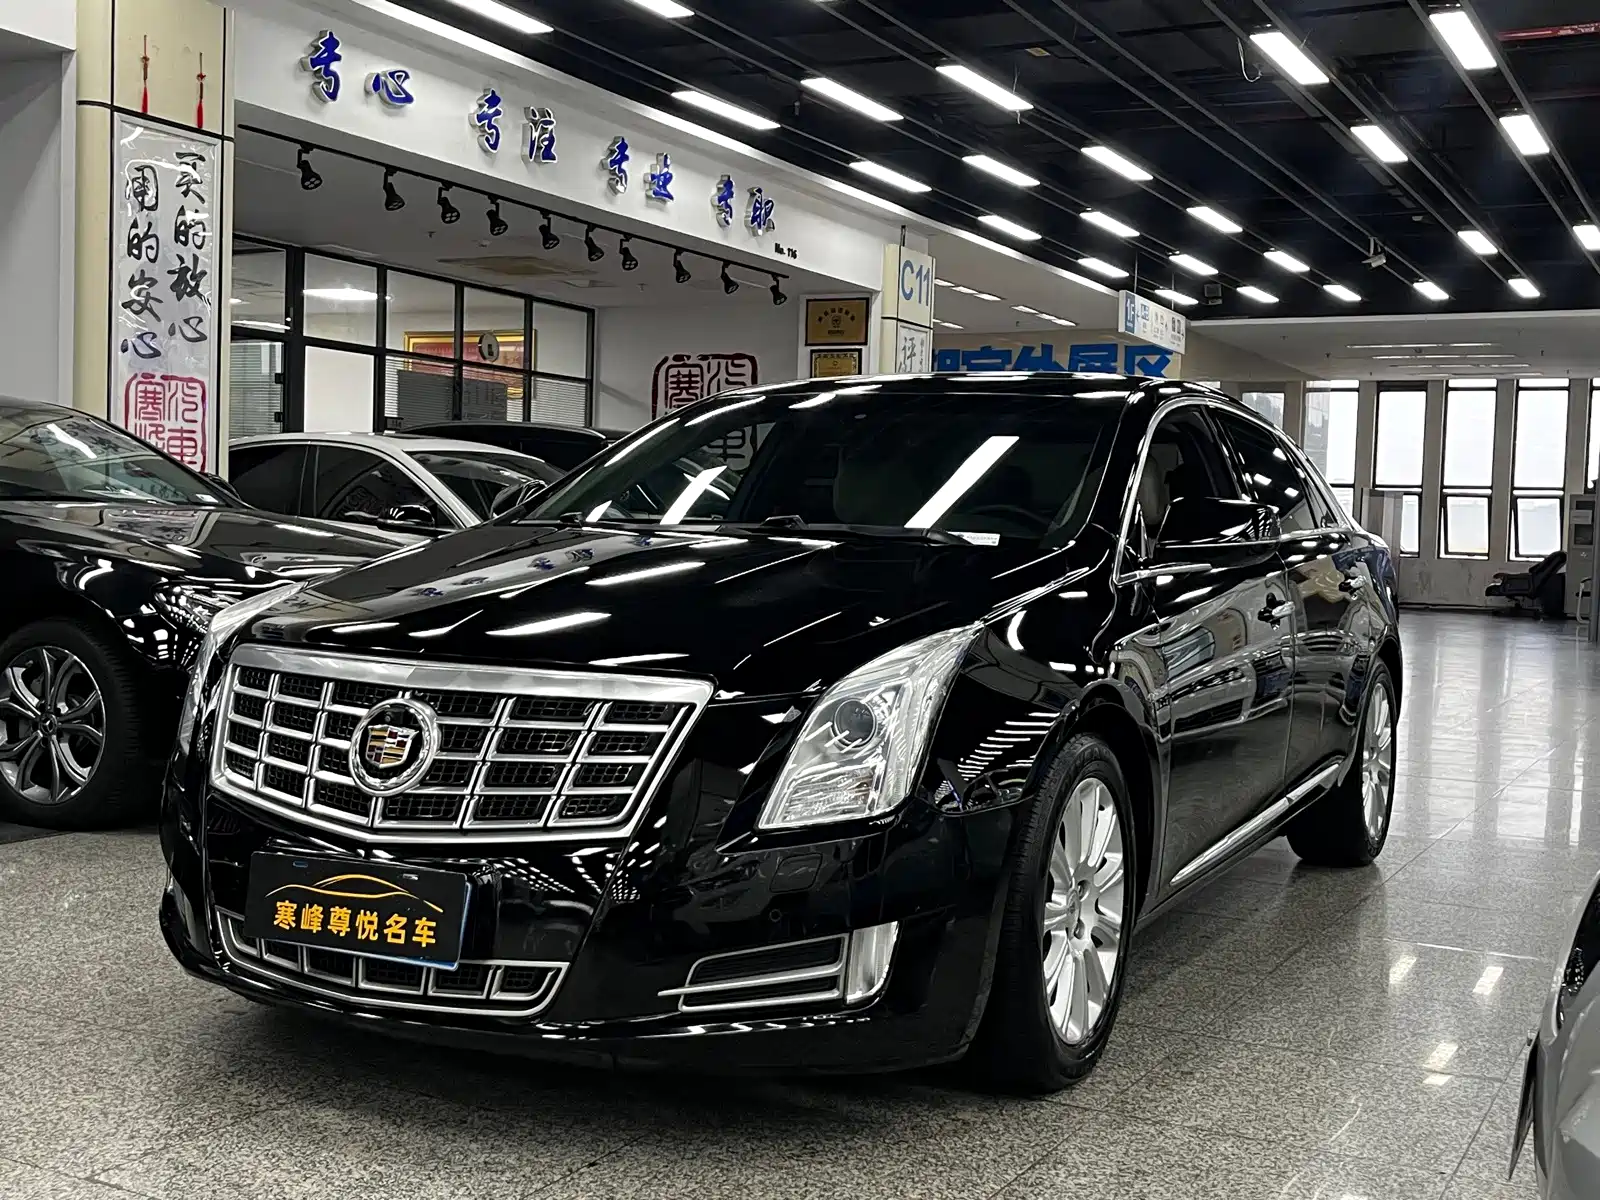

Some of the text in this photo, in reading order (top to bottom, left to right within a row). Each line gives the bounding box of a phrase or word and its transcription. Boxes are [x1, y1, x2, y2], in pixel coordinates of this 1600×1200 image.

[304, 30, 415, 105] 专心
[471, 87, 558, 163] 专注
[602, 135, 675, 201] 专业
[167, 151, 209, 343] 买的放心
[901, 259, 931, 307] C11
[273, 899, 437, 948] 寒峰尊悦名车
